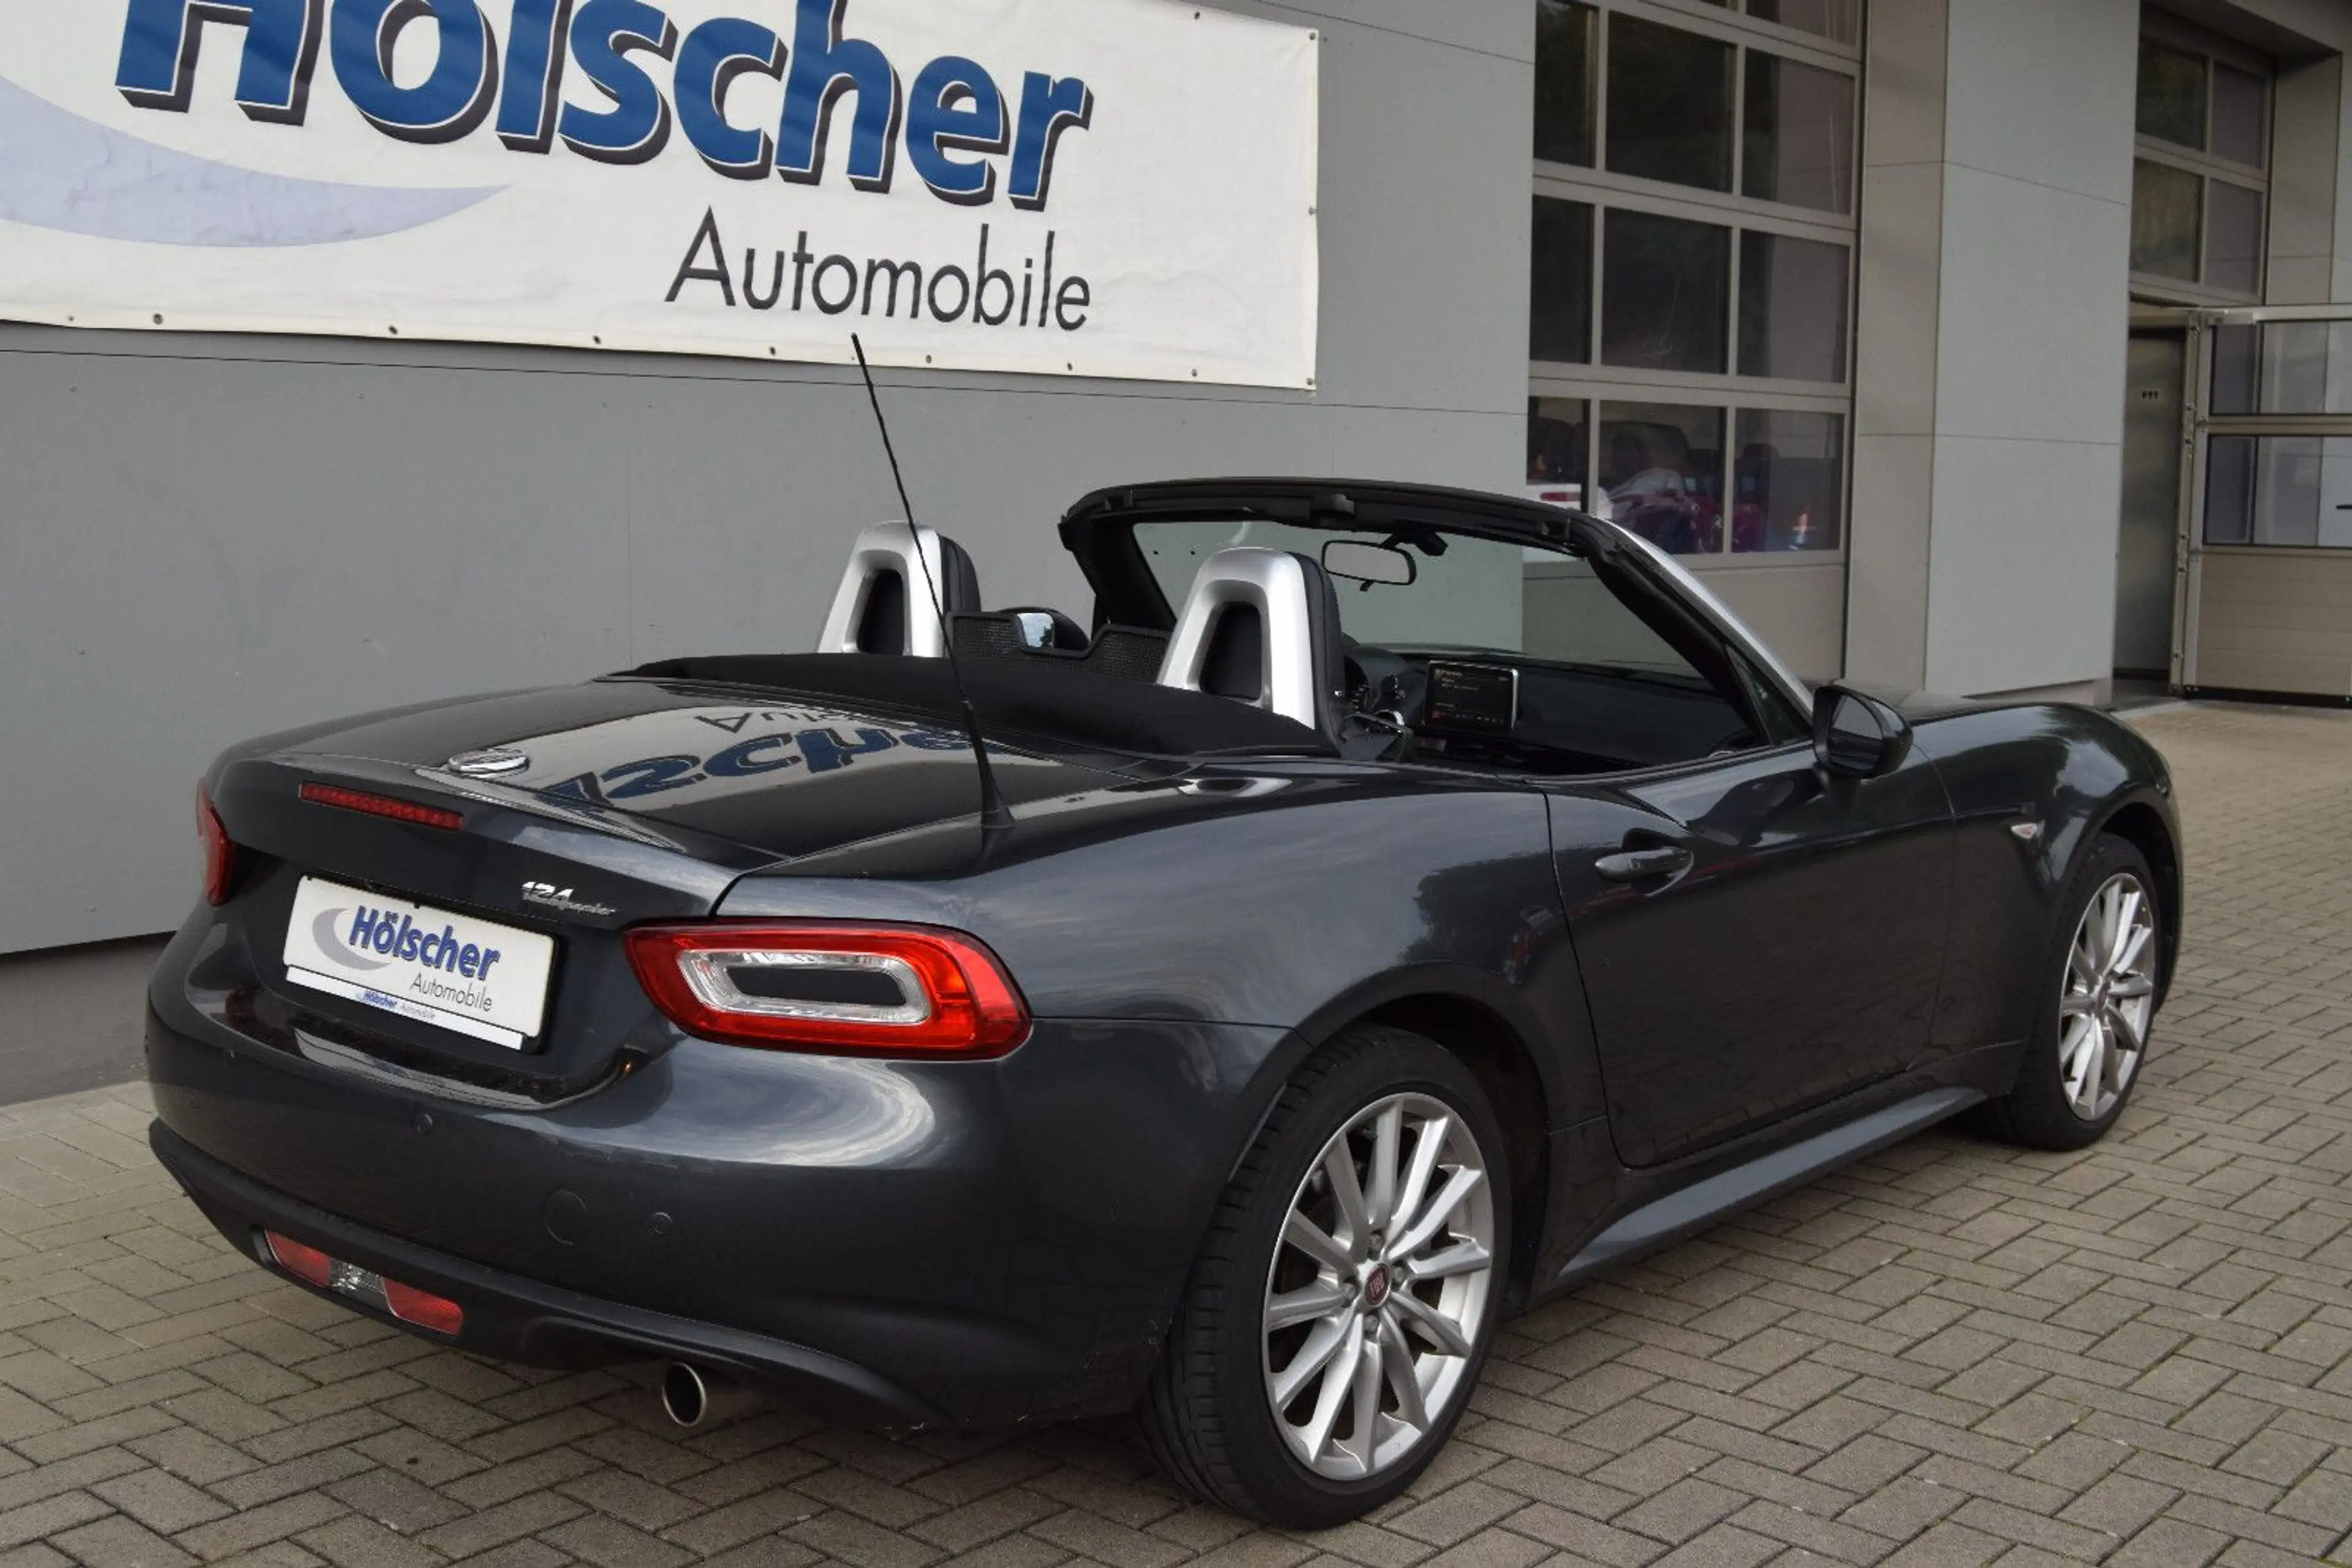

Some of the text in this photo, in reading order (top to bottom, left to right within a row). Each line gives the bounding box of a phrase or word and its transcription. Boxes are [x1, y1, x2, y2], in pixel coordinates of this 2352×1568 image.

[664, 205, 1091, 331] Automobile
[522, 881, 575, 911] 124
[349, 905, 501, 981] Hölscher
[409, 972, 492, 1012] Automobile
